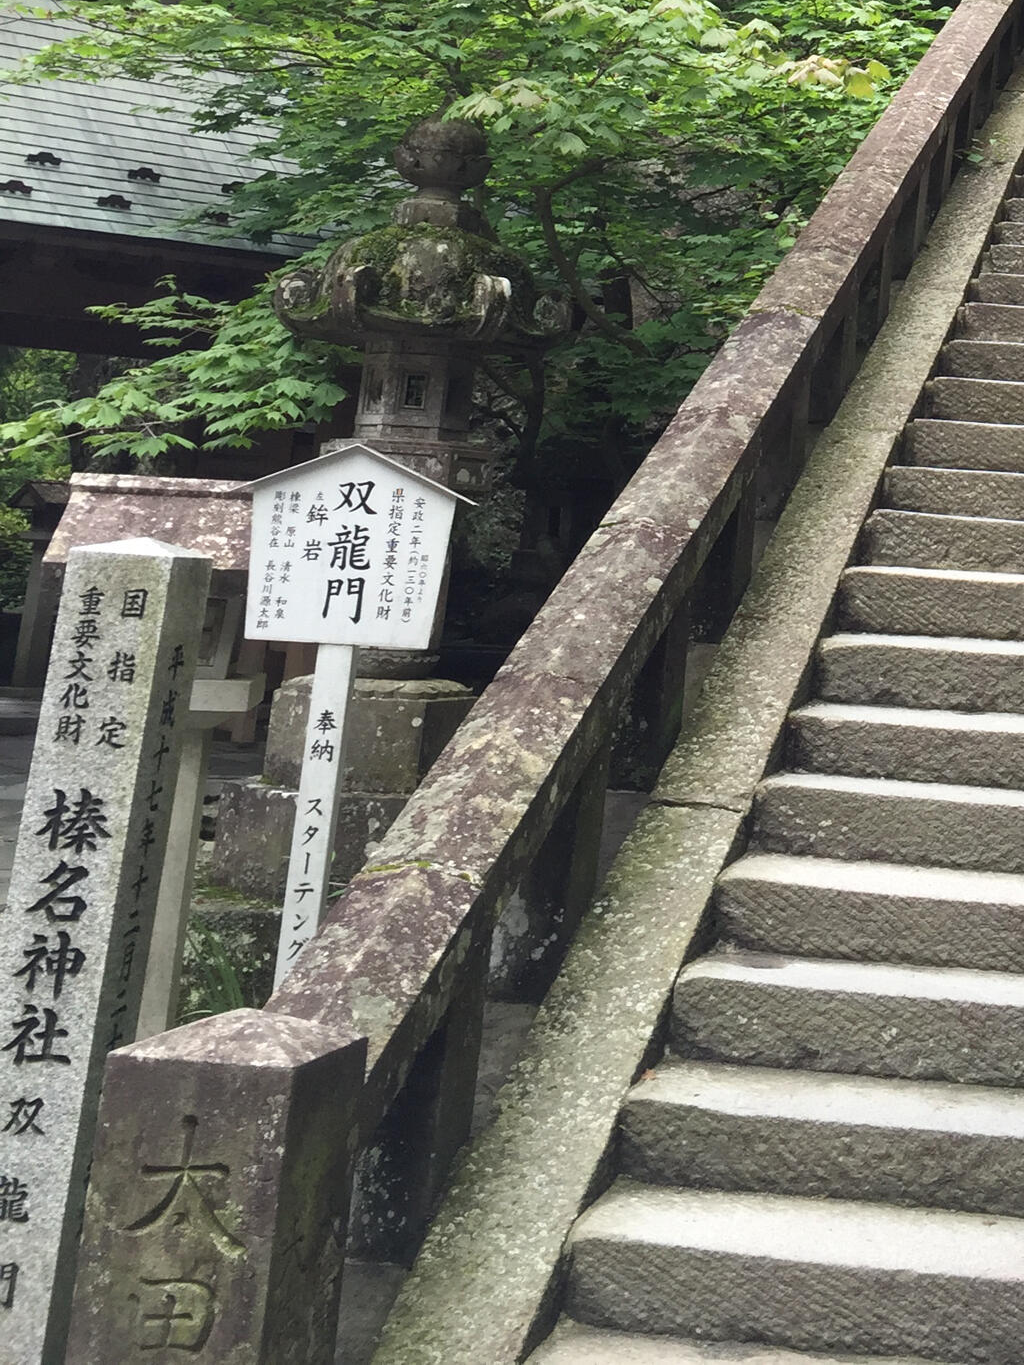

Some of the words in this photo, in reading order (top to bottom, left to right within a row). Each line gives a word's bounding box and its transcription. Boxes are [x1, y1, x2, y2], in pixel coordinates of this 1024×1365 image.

[279, 560, 292, 583] 清水
[284, 526, 296, 548] 原山
[322, 480, 378, 625] 双龍門
[375, 488, 405, 621] 県指定重要文化財
[274, 596, 287, 619] 和泉
[52, 586, 105, 745] 重要文化財
[309, 709, 338, 763] 奉納
[1, 787, 113, 1066] 榛名神社
